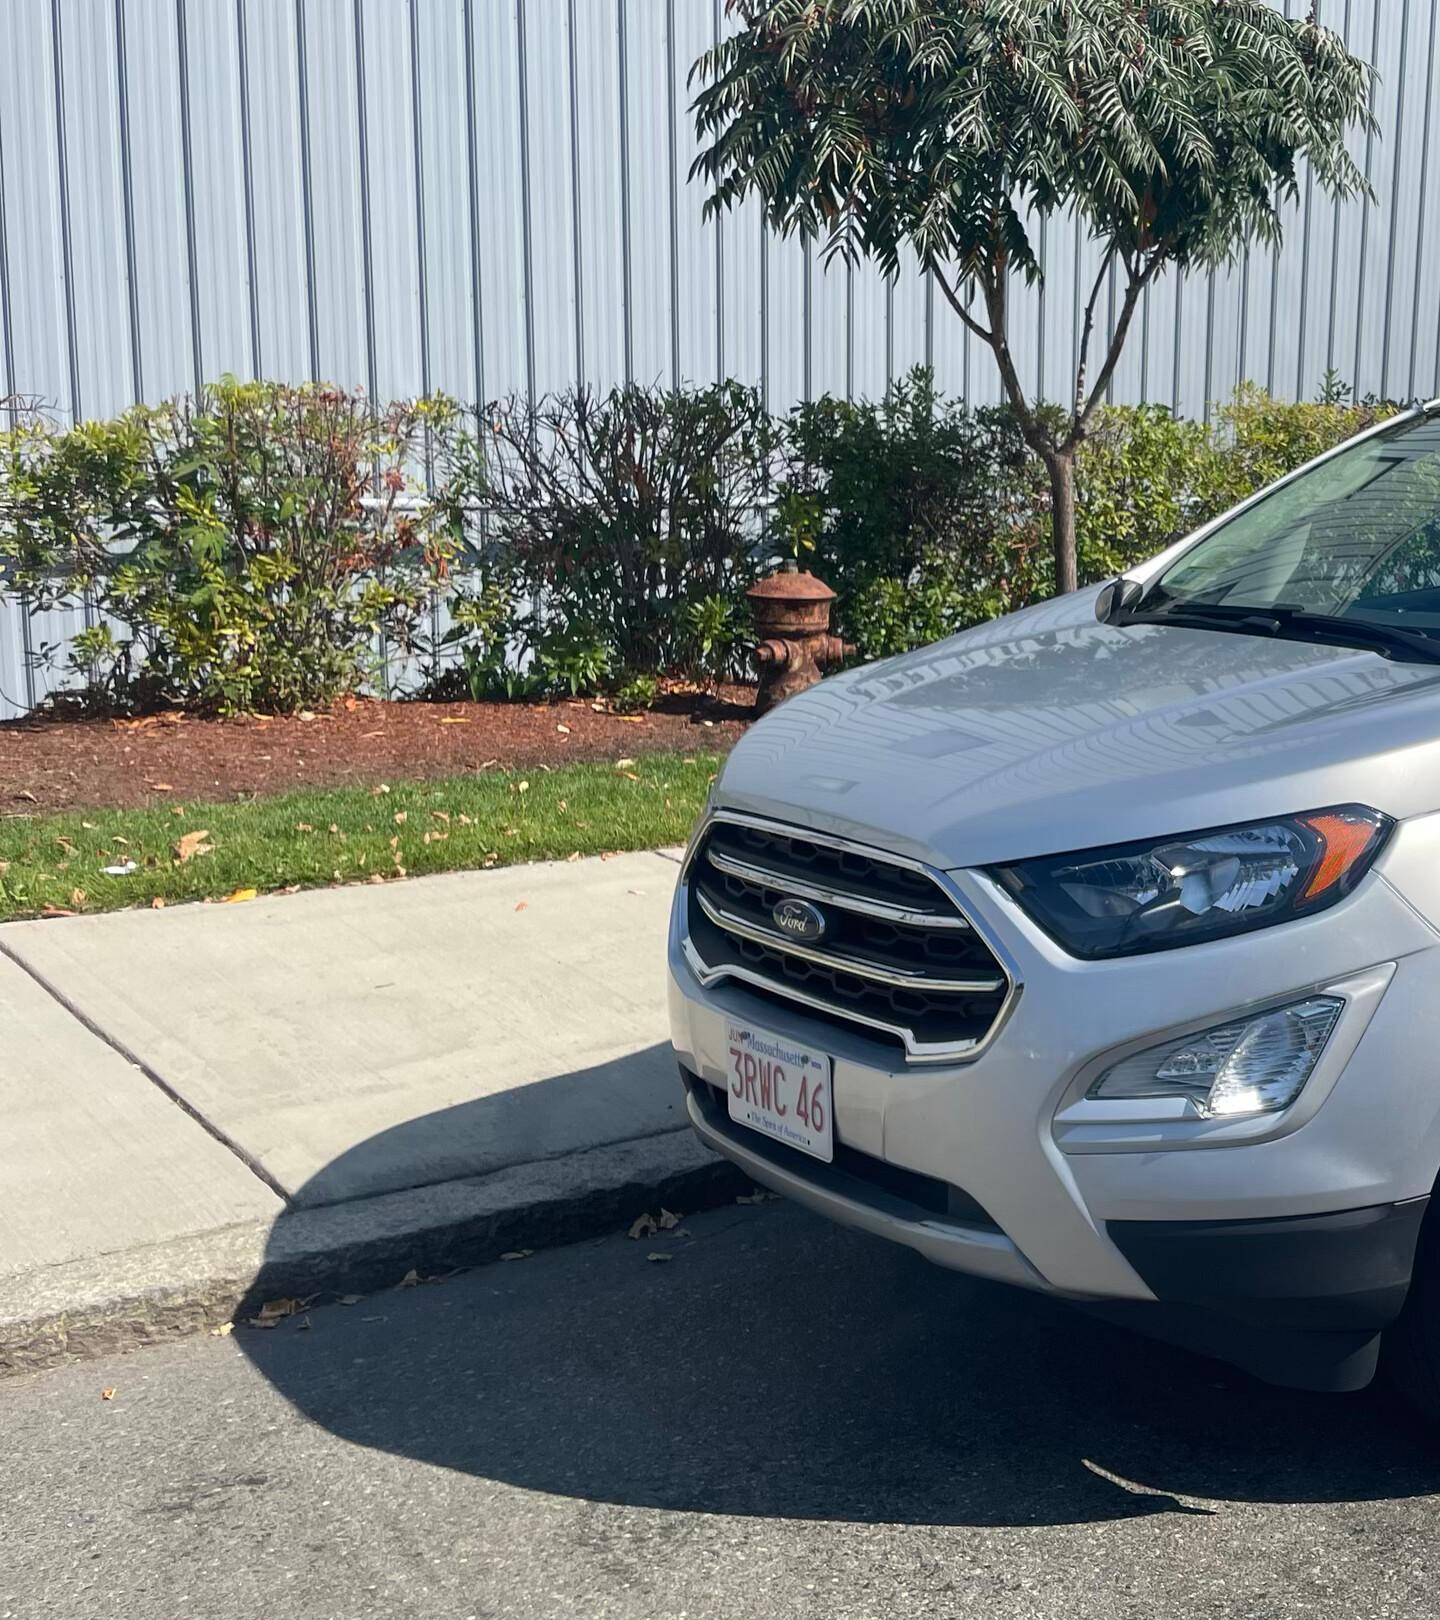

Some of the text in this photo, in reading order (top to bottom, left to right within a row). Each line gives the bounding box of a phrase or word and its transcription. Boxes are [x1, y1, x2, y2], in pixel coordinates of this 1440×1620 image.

[780, 905, 808, 932] Ford
[730, 1048, 825, 1133] 3RWC 46
